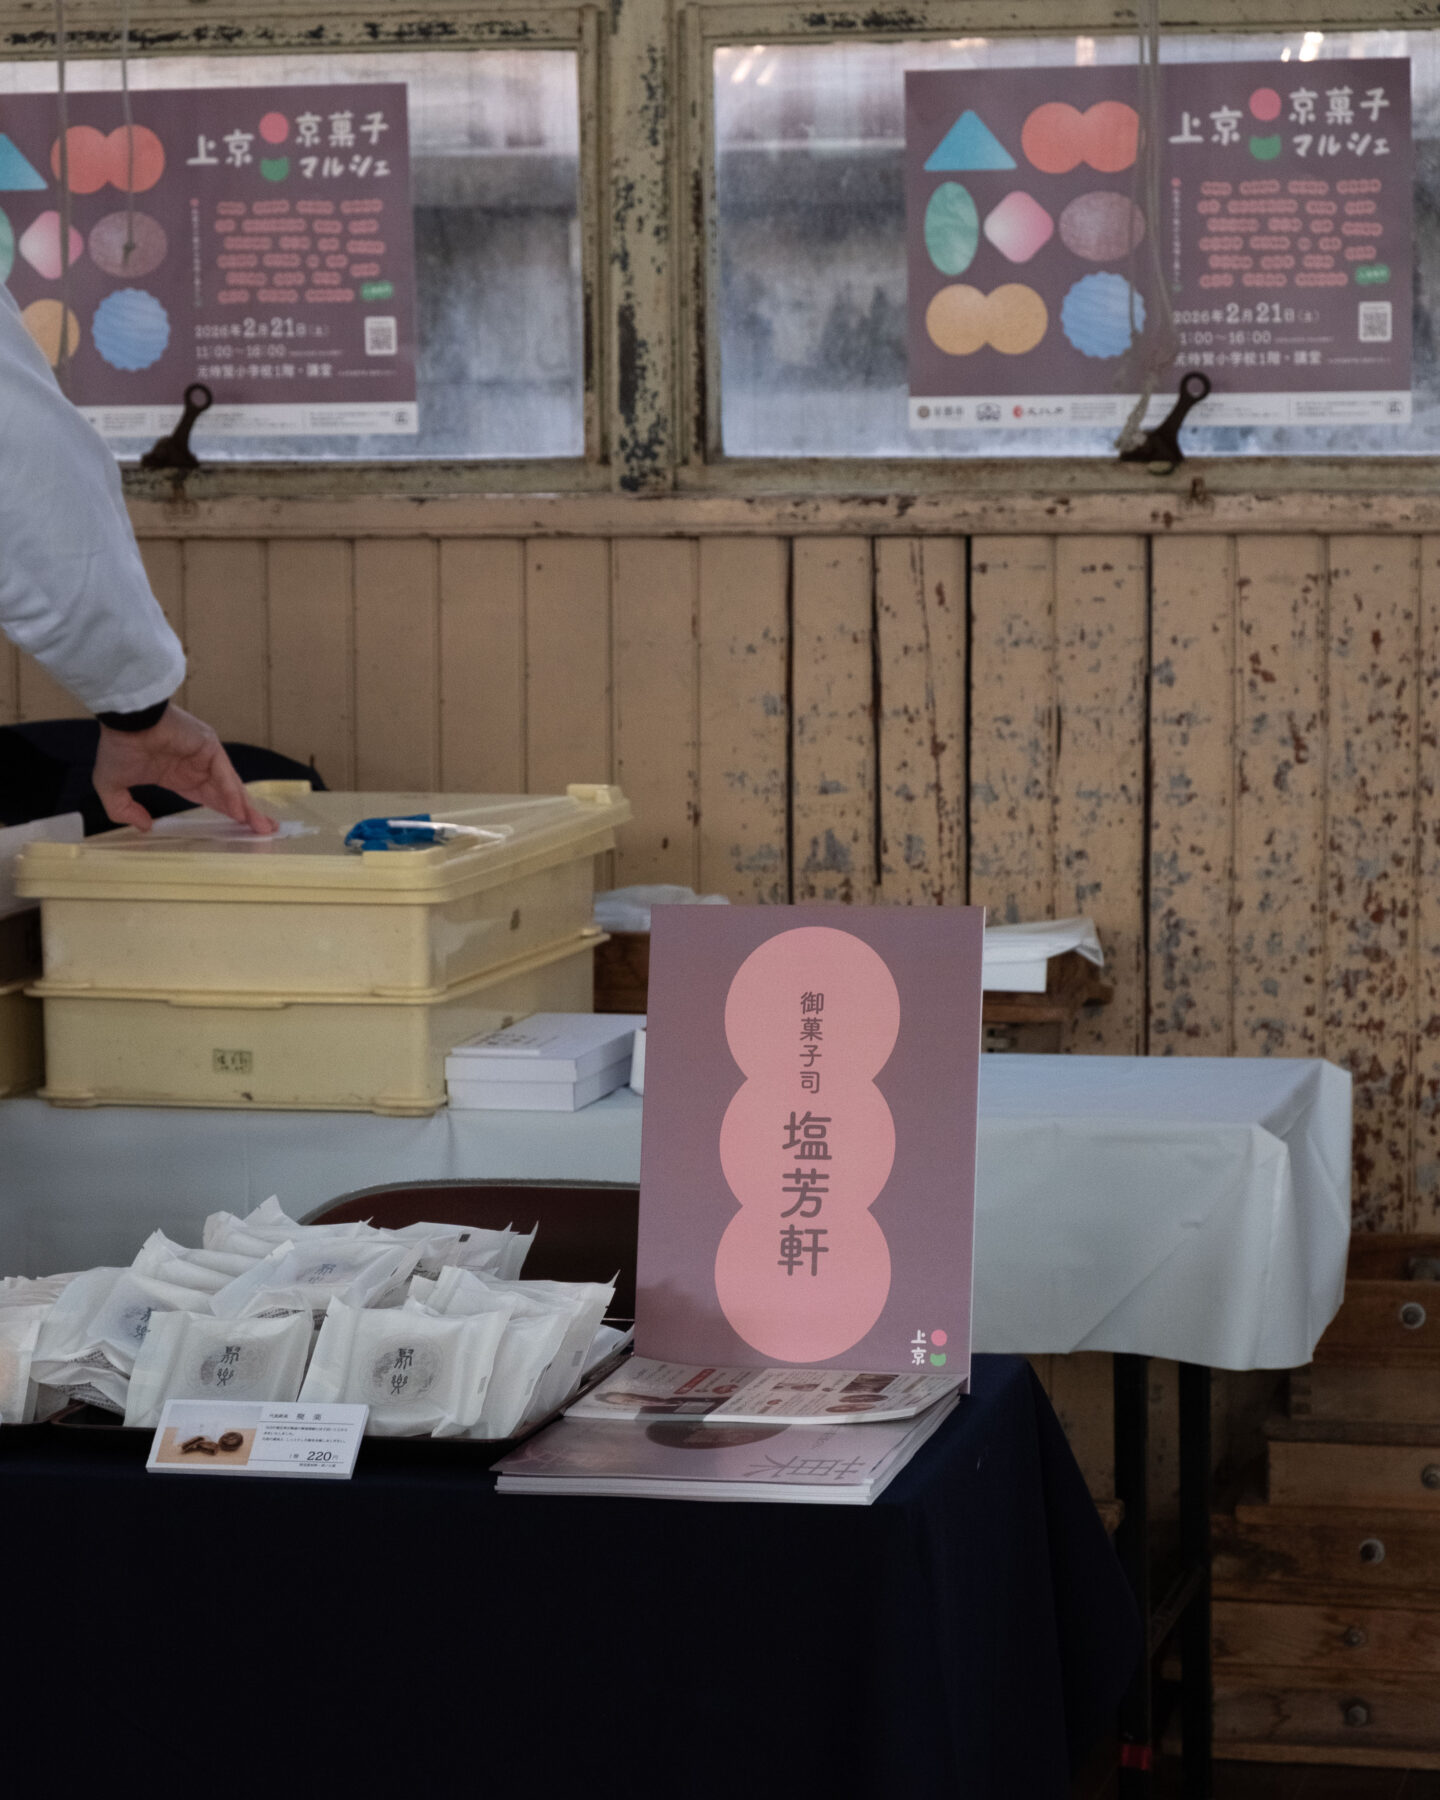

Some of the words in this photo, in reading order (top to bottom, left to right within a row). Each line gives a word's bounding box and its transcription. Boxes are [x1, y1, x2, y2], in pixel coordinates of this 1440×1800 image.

[1289, 87, 1390, 125] 京菓子
[295, 111, 389, 147] 京菓子
[1169, 105, 1243, 146] 上京
[1292, 132, 1390, 157] マルシェ
[186, 129, 254, 167] 上京
[299, 154, 390, 178] マルシェ
[799, 991, 824, 1094] 御菓子司
[777, 1111, 832, 1277] 塩芳軒
[911, 1329, 927, 1366] 上京
